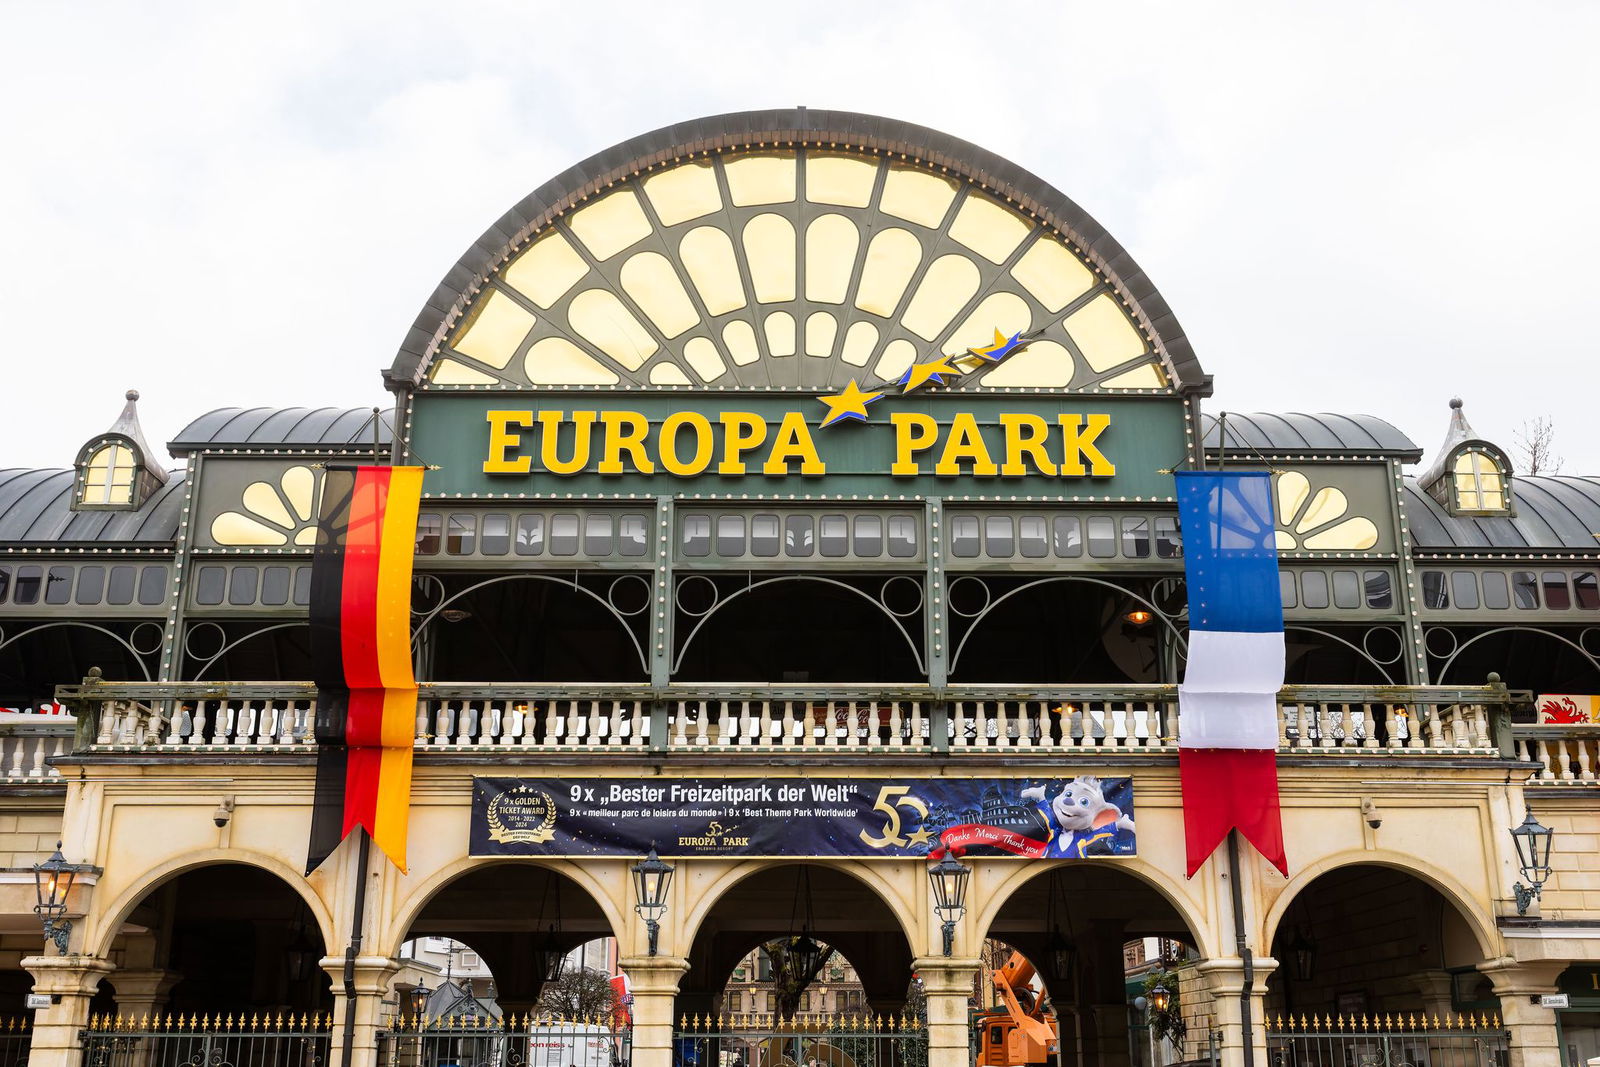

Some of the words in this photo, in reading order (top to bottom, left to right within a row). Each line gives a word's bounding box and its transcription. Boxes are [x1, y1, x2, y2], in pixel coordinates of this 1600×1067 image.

[483, 410, 826, 476] EUROPA
[890, 412, 1116, 477] PARK
[671, 784, 772, 805] Freizeitpark
[778, 784, 806, 802] der
[811, 784, 858, 802] Welt“
[515, 797, 541, 805] GOLDEN
[499, 806, 521, 814] TICKET
[521, 806, 545, 815] AWARD
[621, 809, 639, 818] parc
[641, 808, 650, 817] de
[653, 808, 677, 817] loisirs
[678, 808, 689, 817] du
[765, 808, 791, 817] Theme
[794, 808, 812, 817] Park
[678, 837, 717, 846] EUROPA
[723, 837, 749, 846] PARK
[946, 829, 970, 844] Danke
[975, 828, 1000, 840] Merci
[1002, 834, 1025, 850] Thank
[1025, 846, 1039, 855] you
